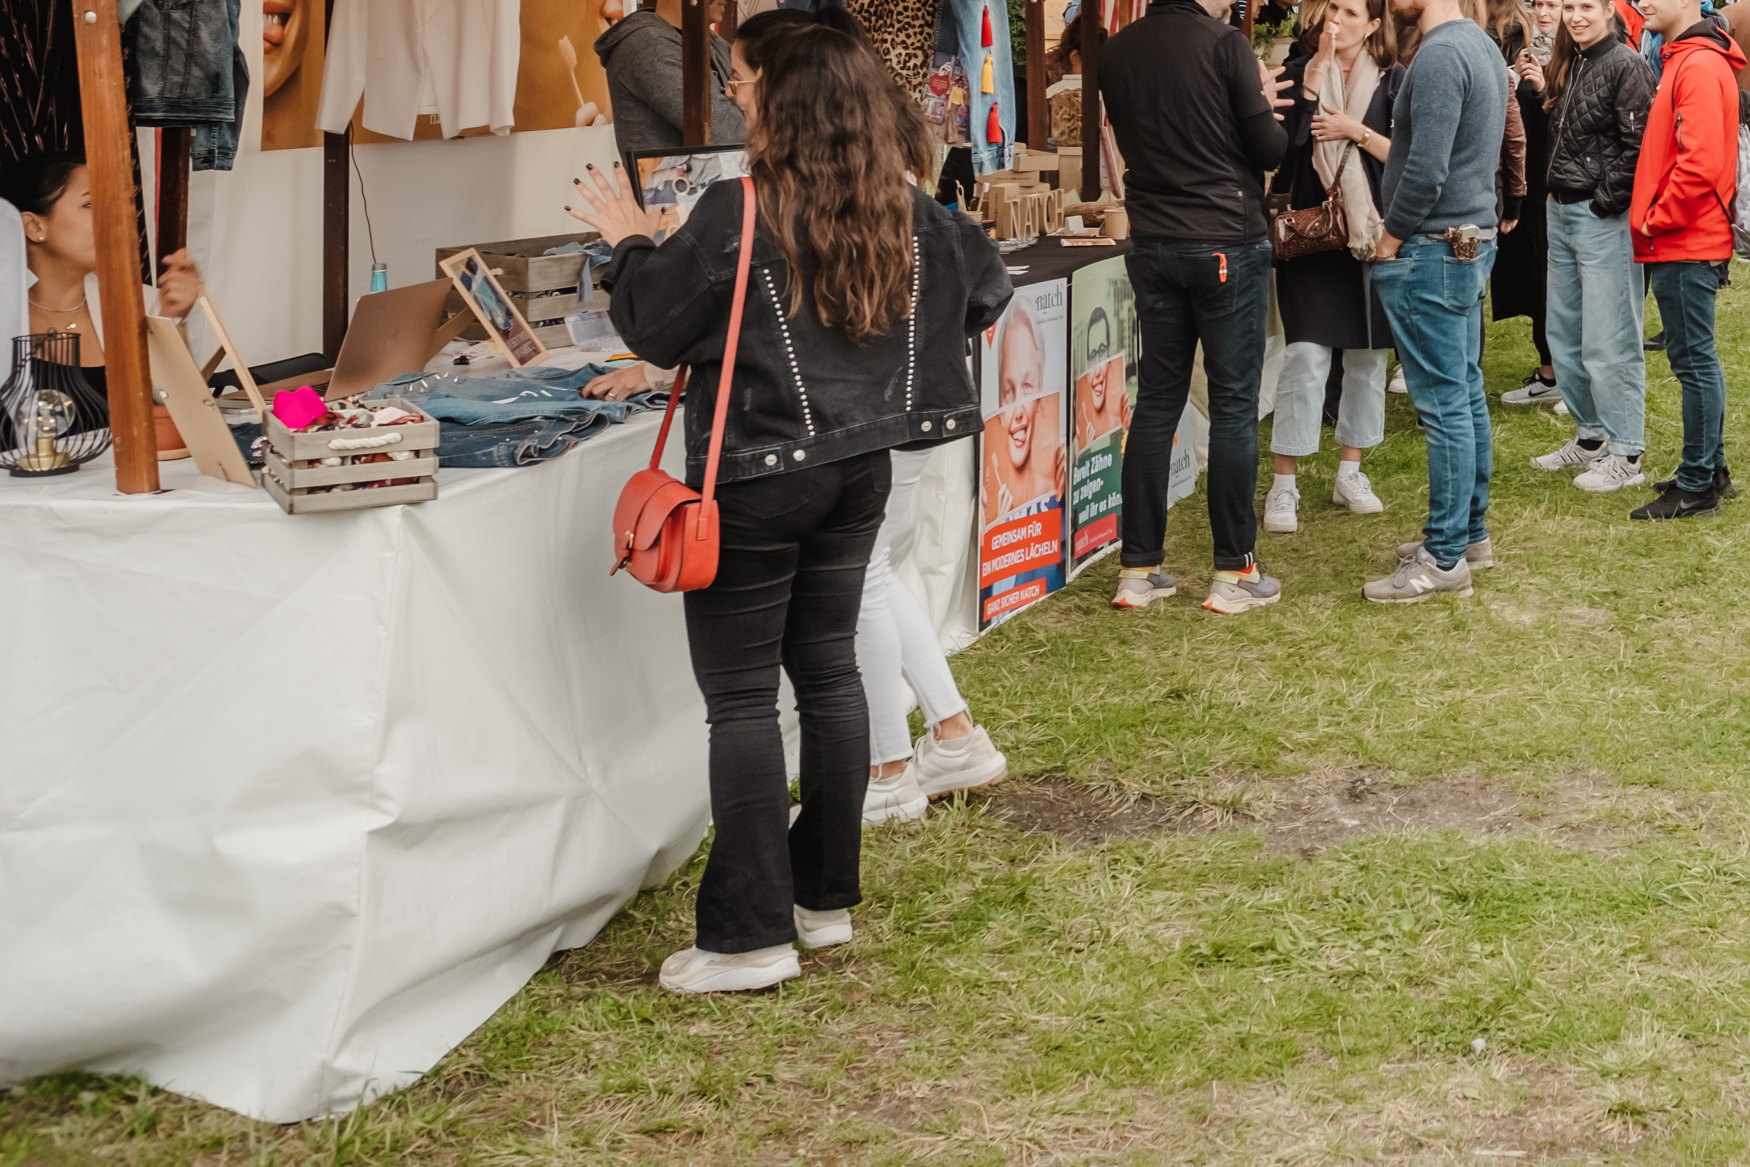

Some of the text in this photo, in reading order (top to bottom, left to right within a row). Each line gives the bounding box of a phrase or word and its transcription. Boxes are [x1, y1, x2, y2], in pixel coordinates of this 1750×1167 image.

[1010, 188, 1065, 240] NATCH
[1035, 284, 1064, 311] natch
[1073, 452, 1112, 486] Bereit Zähne
[1073, 488, 1080, 506] zu
[1079, 504, 1090, 525] weil
[1090, 501, 1099, 518] ihr
[1099, 498, 1107, 513] es
[991, 520, 1042, 551] GEMEINSAM FÜR
[982, 538, 1058, 578] EIN MODERNES LÄCHELN
[986, 584, 1040, 616] GANZ SICHER NATCH
